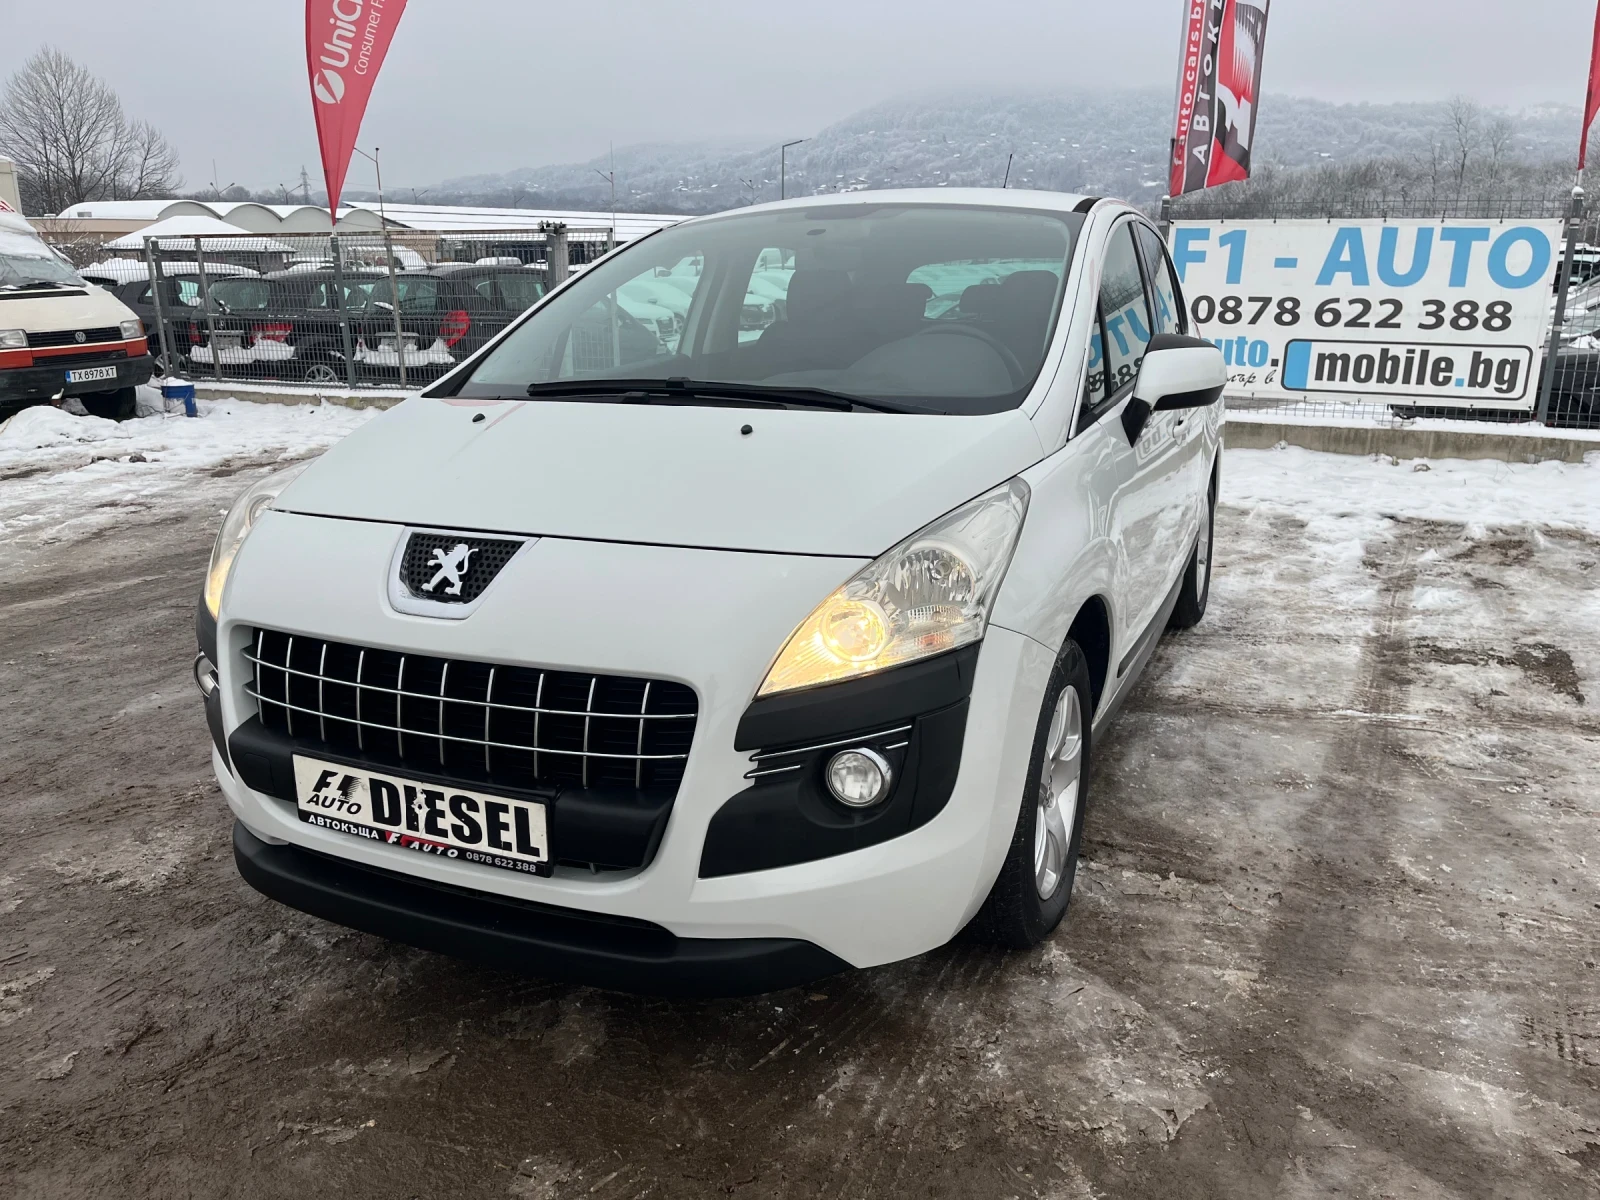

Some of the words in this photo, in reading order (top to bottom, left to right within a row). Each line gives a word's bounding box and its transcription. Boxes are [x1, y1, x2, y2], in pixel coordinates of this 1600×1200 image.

[320, 0, 363, 68] UniC
[354, 9, 381, 75] Consumer
[1172, 227, 1247, 285] F1
[1315, 226, 1551, 289] AUTO
[1190, 294, 1301, 327] 0878
[1314, 297, 1403, 329] 622
[1417, 299, 1513, 332] 388
[71, 370, 84, 382] TX
[85, 368, 104, 380] 8978
[105, 367, 116, 378] XT
[1314, 347, 1521, 394] mobile.bg
[306, 793, 362, 816] AUTO
[369, 777, 541, 858] DIESEL
[308, 814, 380, 841] АВТОКЪЩА
[409, 840, 459, 858] AUTO
[465, 851, 494, 864] 0878
[494, 857, 514, 869] 622
[515, 861, 537, 873] 388
